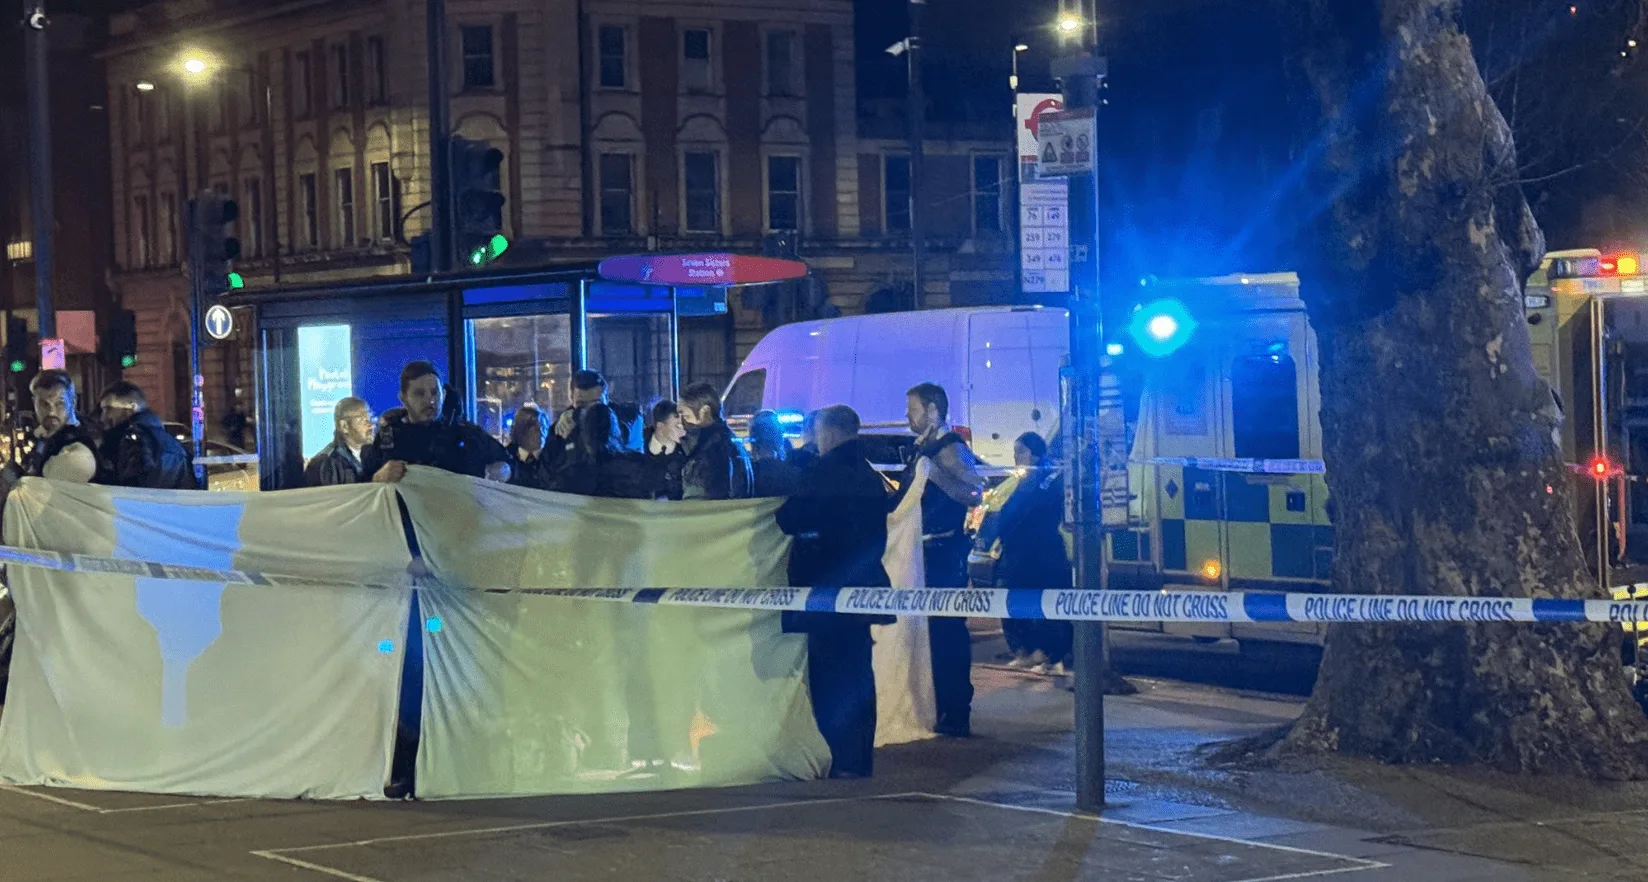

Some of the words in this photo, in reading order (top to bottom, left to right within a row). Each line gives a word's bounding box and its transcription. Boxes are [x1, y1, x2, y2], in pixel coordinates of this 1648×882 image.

[1025, 233, 1040, 242] 259
[1047, 233, 1061, 242] 279
[682, 258, 704, 267] Seven
[1026, 255, 1041, 263] 349
[688, 269, 715, 277] Station
[1023, 276, 1045, 285] N279
[760, 588, 799, 606] CROSS
[846, 589, 888, 609] POLICE
[885, 589, 914, 610] LINE
[911, 590, 931, 611] DO
[929, 590, 955, 611] NOT
[954, 590, 994, 612] CROSS
[1056, 592, 1099, 615] POLICE
[1101, 592, 1129, 616] LINE
[1131, 593, 1150, 617] DO
[1153, 594, 1180, 618] NOT
[1182, 594, 1228, 619] CROSS
[1304, 596, 1356, 621] POLICE
[1359, 597, 1393, 621] LINE
[1396, 598, 1417, 622] DO
[1422, 598, 1454, 622] NOT
[1458, 599, 1514, 622] CROSS
